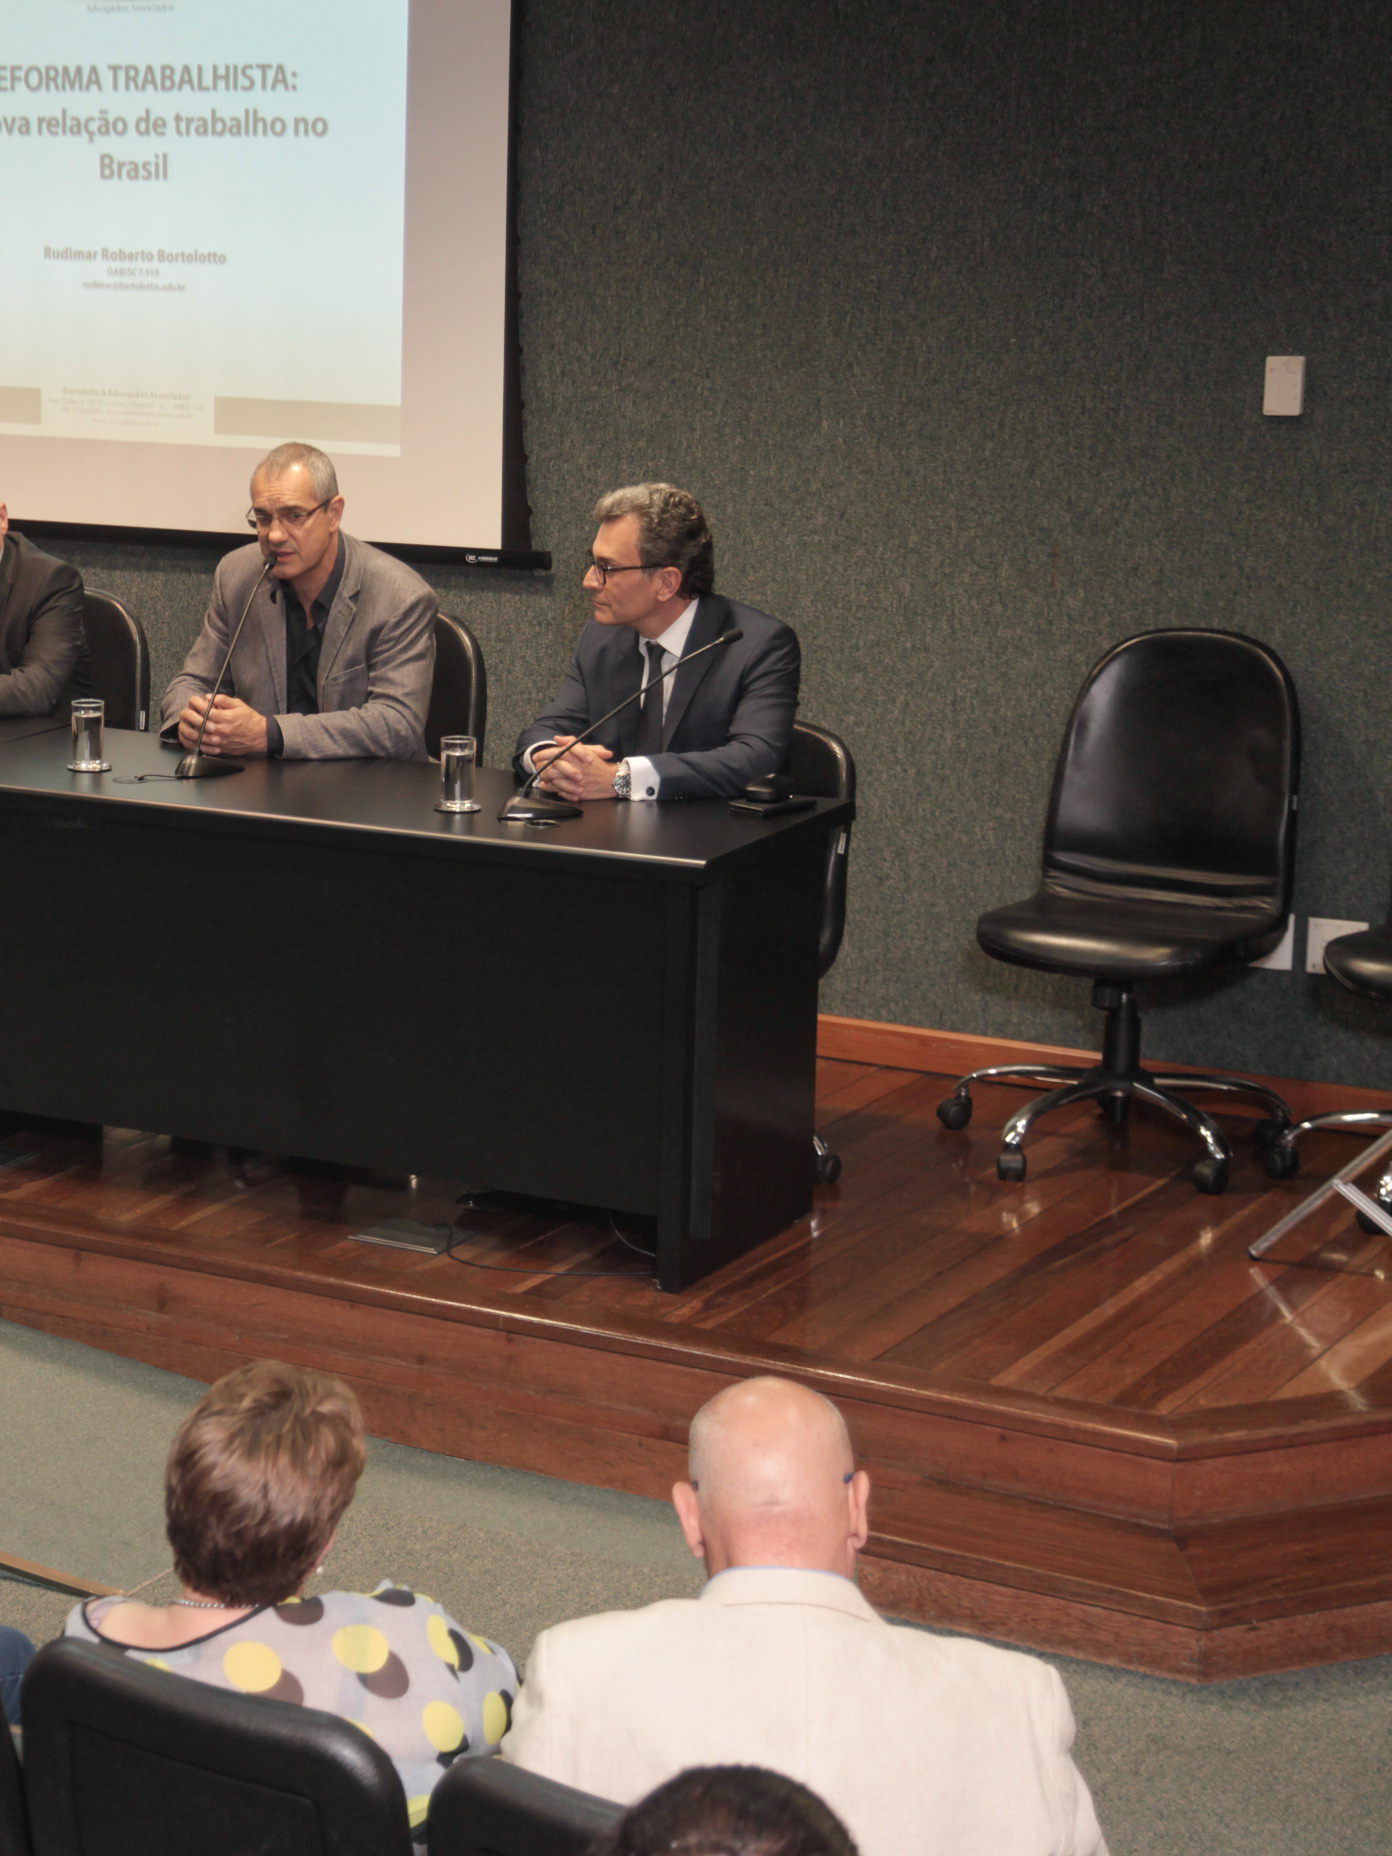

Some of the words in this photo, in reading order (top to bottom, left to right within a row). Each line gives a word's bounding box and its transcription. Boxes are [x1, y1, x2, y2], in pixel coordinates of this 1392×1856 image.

[107, 63, 298, 92] TRABALHISTA:
[37, 109, 128, 143] relação
[134, 109, 167, 137] de
[174, 109, 286, 138] trabalho
[293, 117, 329, 137] no
[99, 153, 169, 181] Brasil
[43, 246, 98, 261] Rudimar
[101, 247, 154, 263] Roberto
[157, 248, 227, 264] Bortolotto
